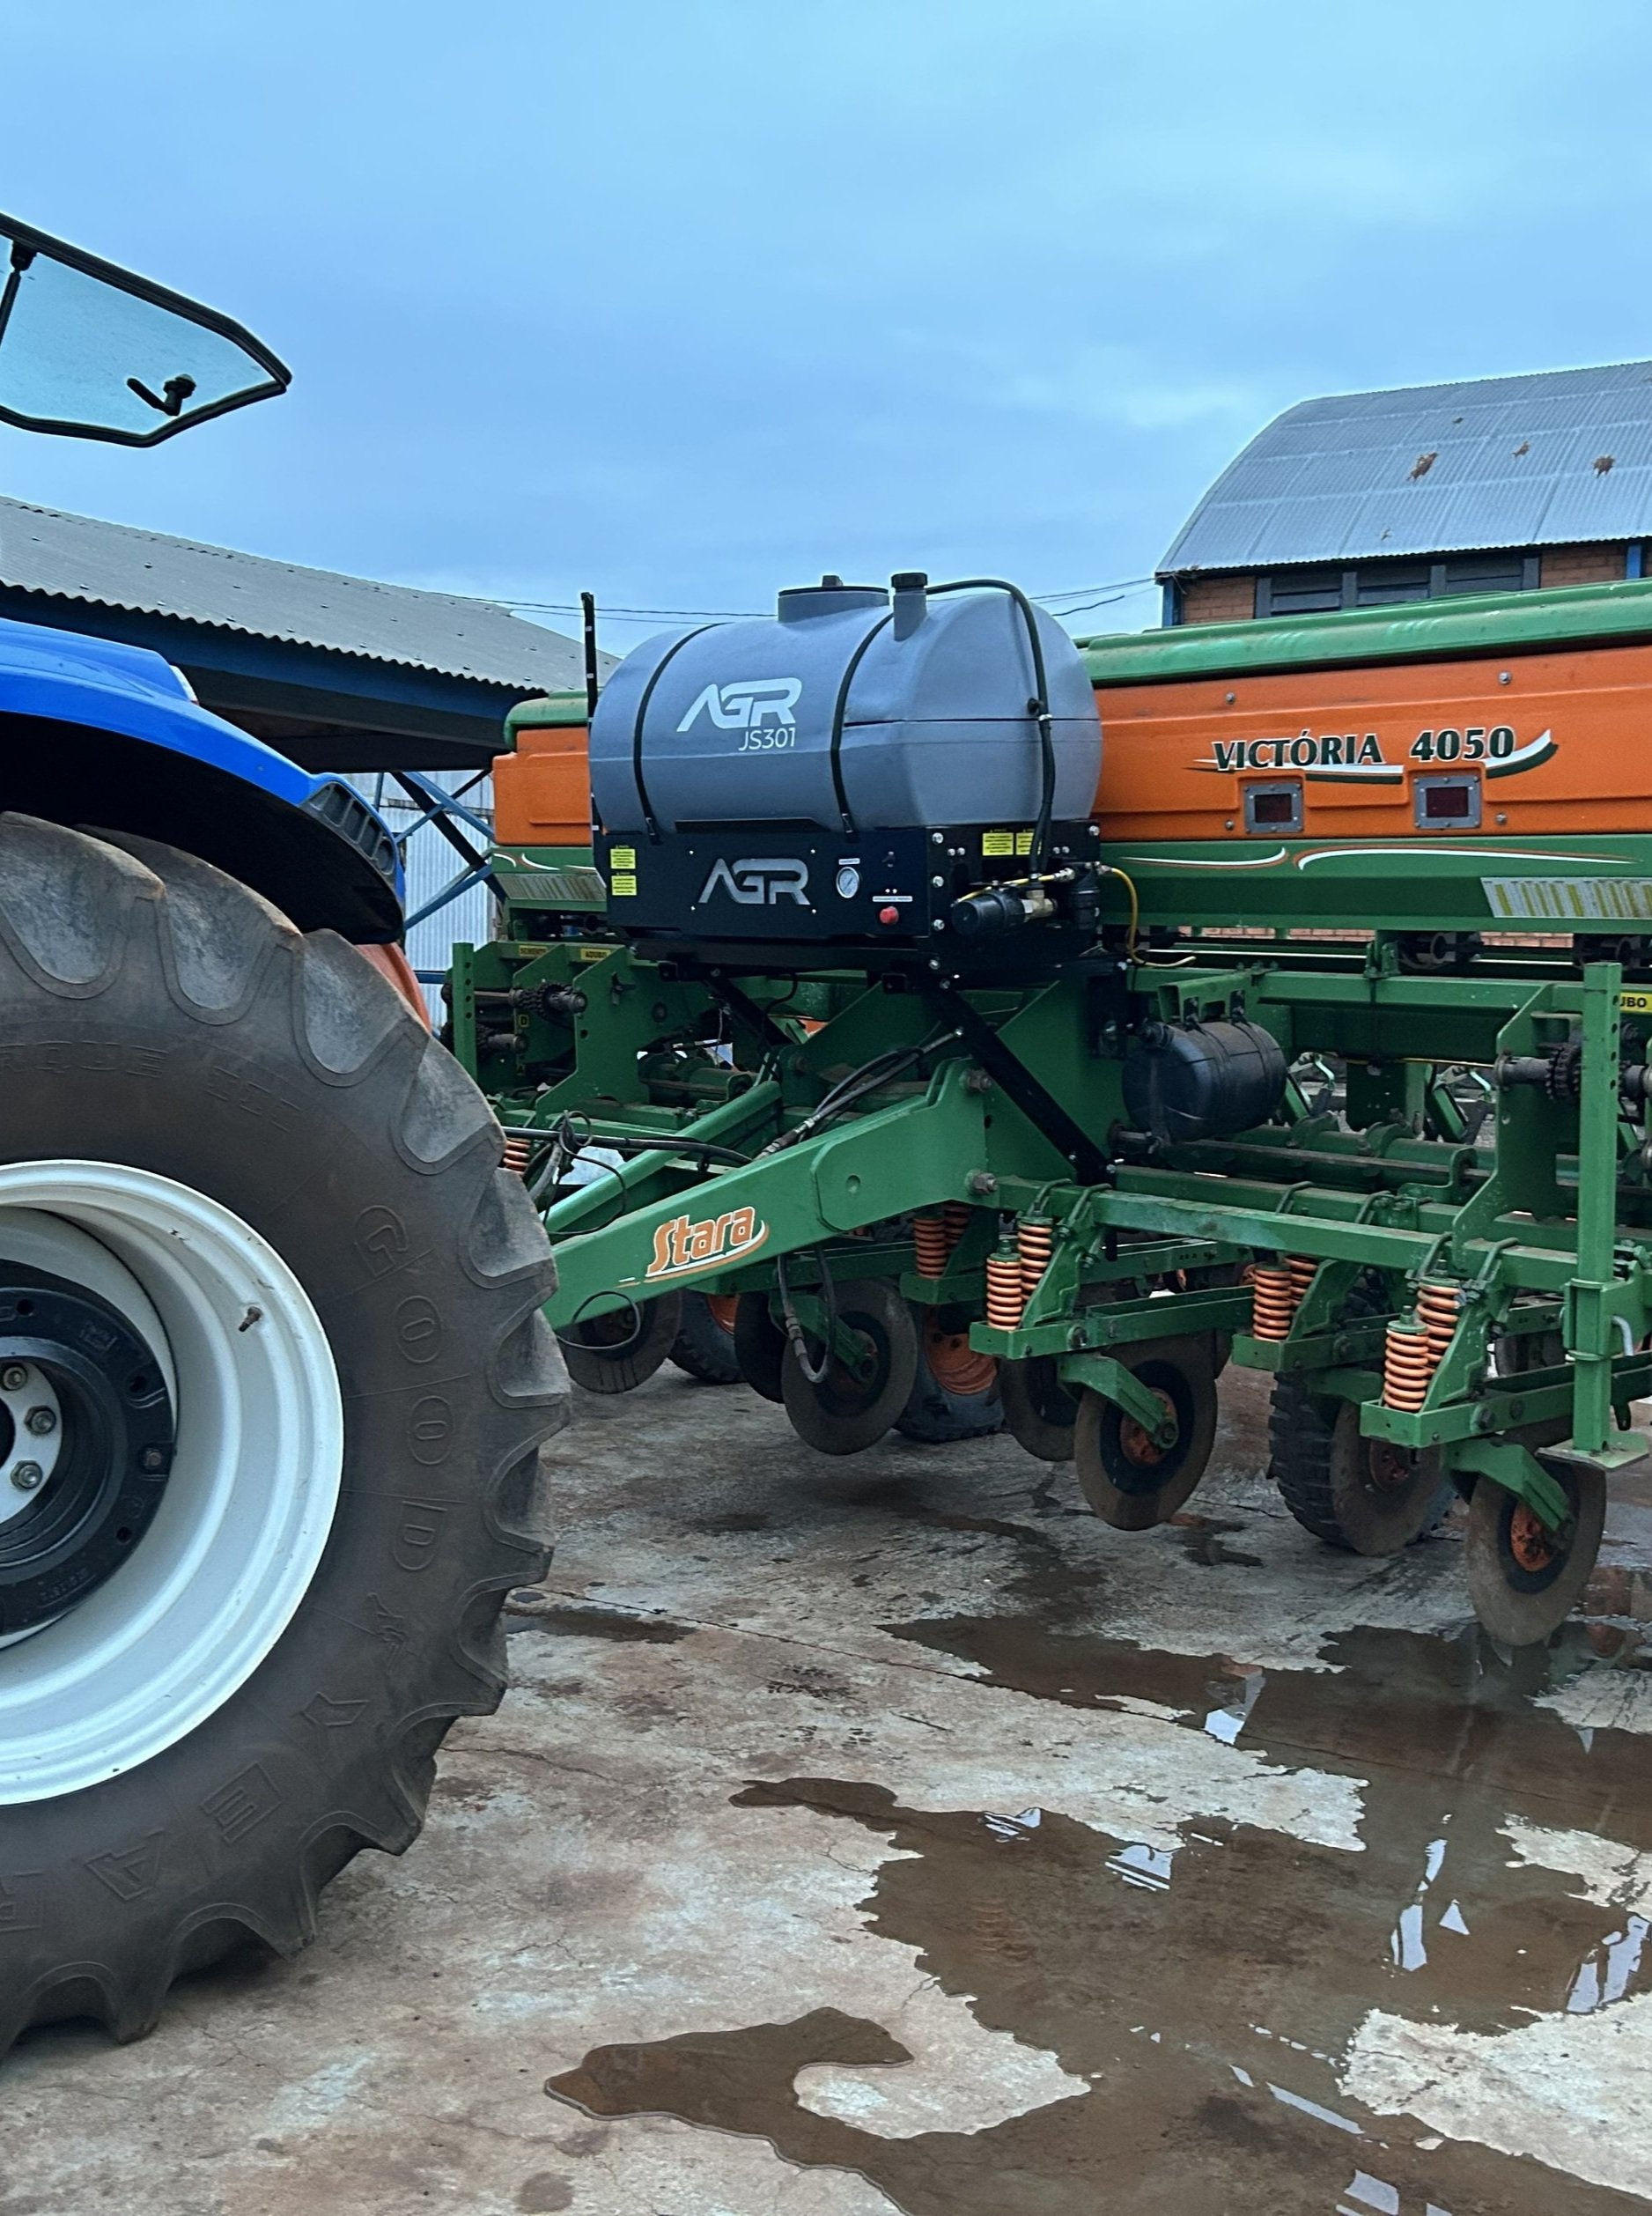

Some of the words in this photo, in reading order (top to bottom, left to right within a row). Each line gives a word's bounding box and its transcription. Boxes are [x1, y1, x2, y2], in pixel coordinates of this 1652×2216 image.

[676, 677, 802, 732] AGR
[738, 728, 796, 751] JS301
[1212, 728, 1386, 772] VICTÓRIA
[1409, 726, 1516, 763] 4050
[697, 858, 811, 905] AGR
[1620, 996, 1648, 1008] UBO
[647, 1206, 756, 1274] Stara
